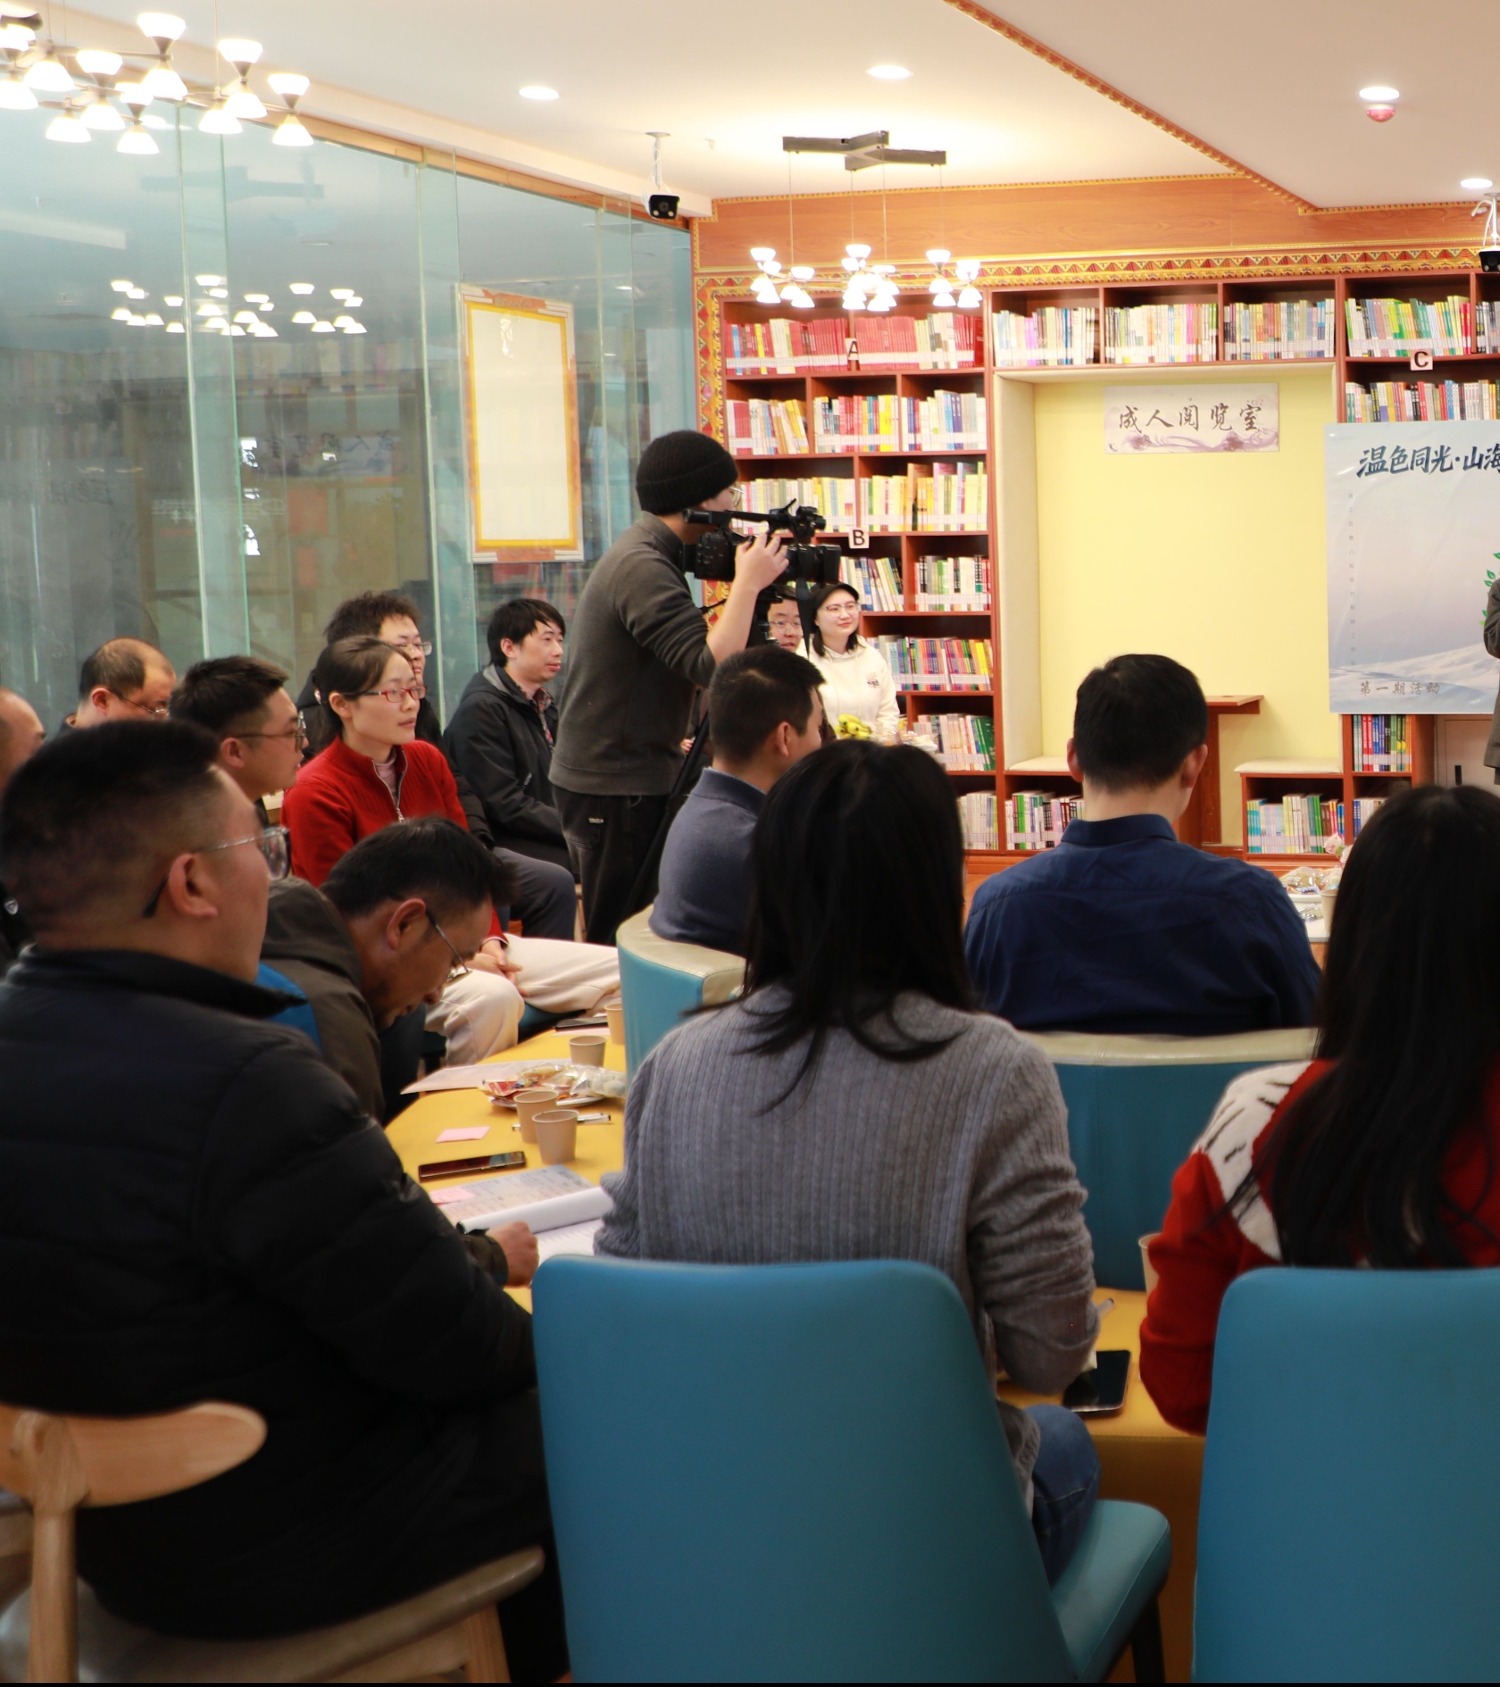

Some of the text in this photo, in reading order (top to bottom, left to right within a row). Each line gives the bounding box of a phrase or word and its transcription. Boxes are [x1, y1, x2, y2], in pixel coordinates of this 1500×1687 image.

[848, 340, 859, 358] A
[1414, 350, 1429, 368] C
[1119, 403, 1262, 433] 成人阅览室
[853, 529, 866, 546] B
[1360, 680, 1440, 697] 第一期活动
